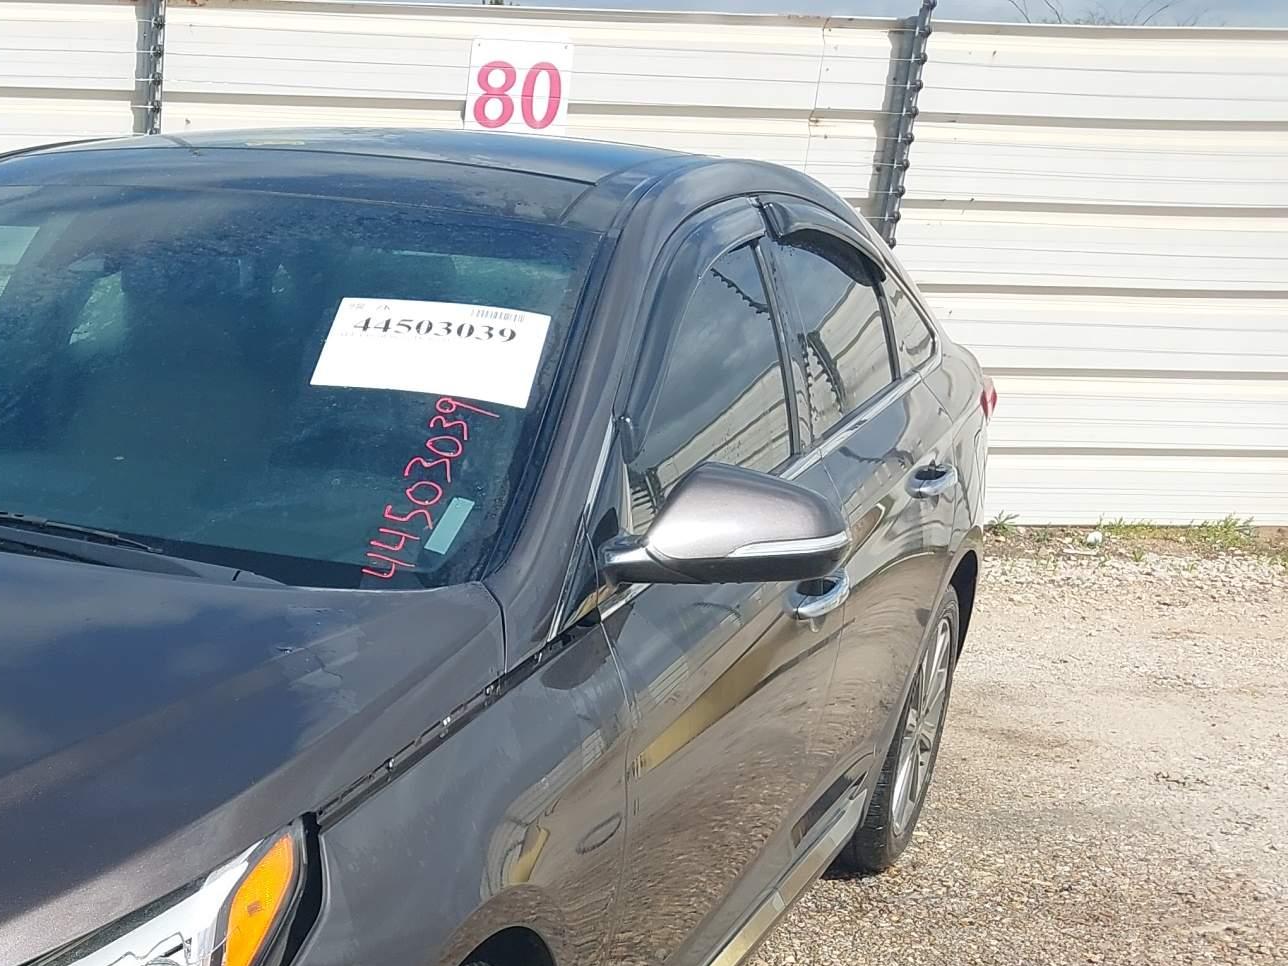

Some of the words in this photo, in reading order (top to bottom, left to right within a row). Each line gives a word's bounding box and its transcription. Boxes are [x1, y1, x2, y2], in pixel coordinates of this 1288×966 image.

[473, 60, 562, 130] 80
[353, 316, 517, 343] 44503039
[361, 397, 500, 578] 44503039
